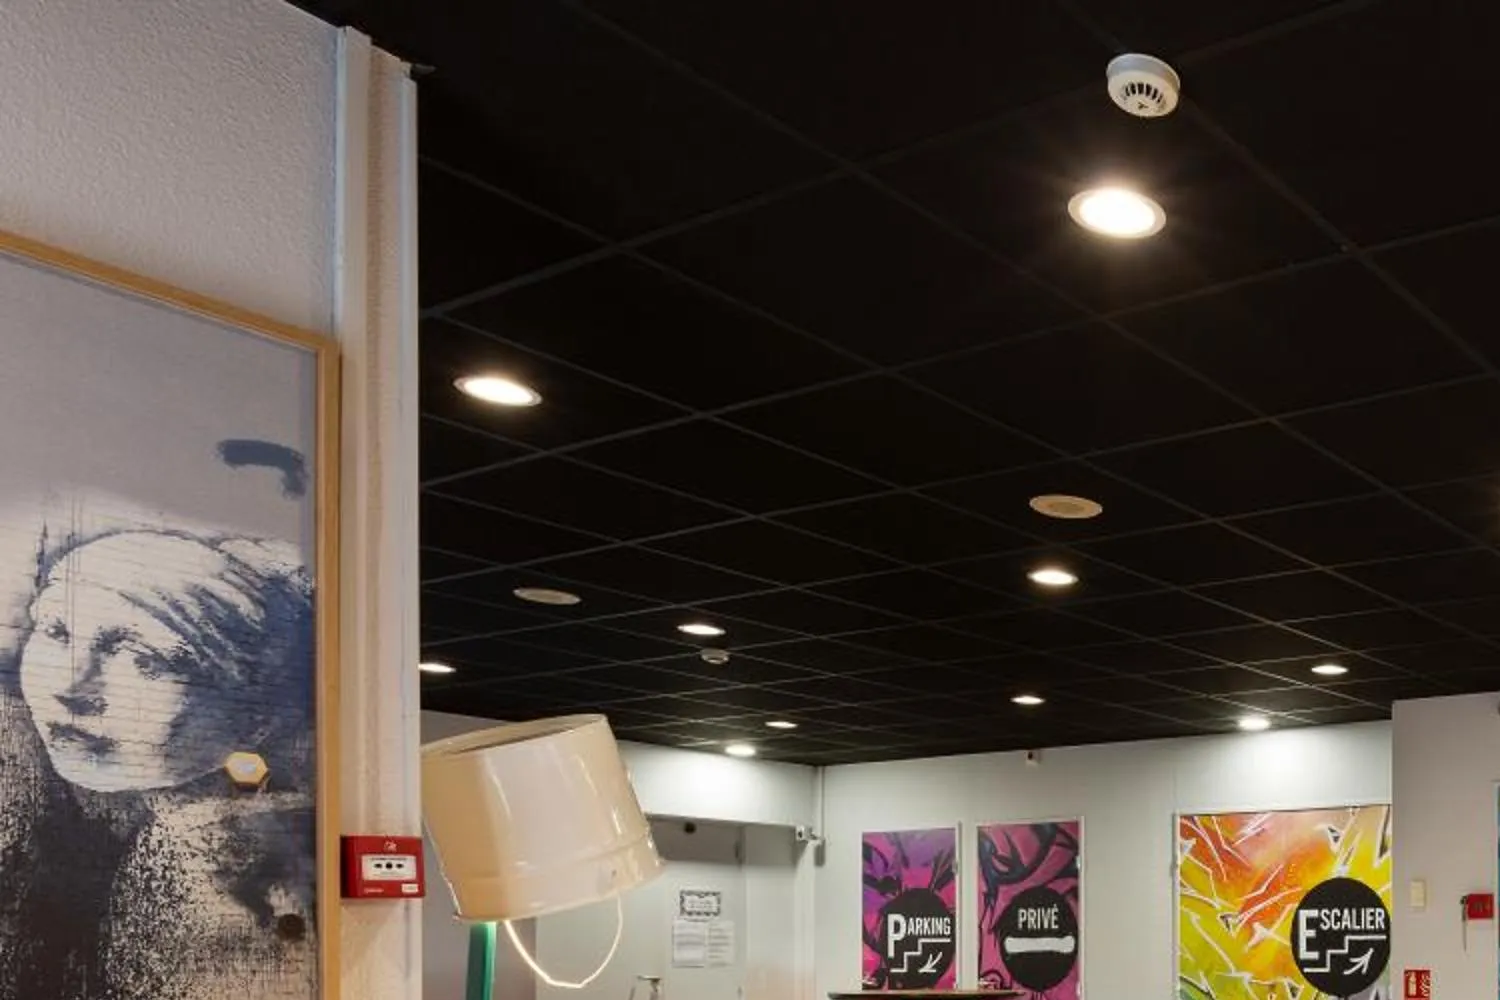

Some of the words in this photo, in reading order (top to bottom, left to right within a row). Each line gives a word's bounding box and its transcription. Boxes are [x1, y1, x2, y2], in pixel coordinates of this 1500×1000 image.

[888, 914, 951, 958] PARKING
[1018, 904, 1059, 929] PRIVÉ
[1299, 908, 1385, 960] ESCALIER
